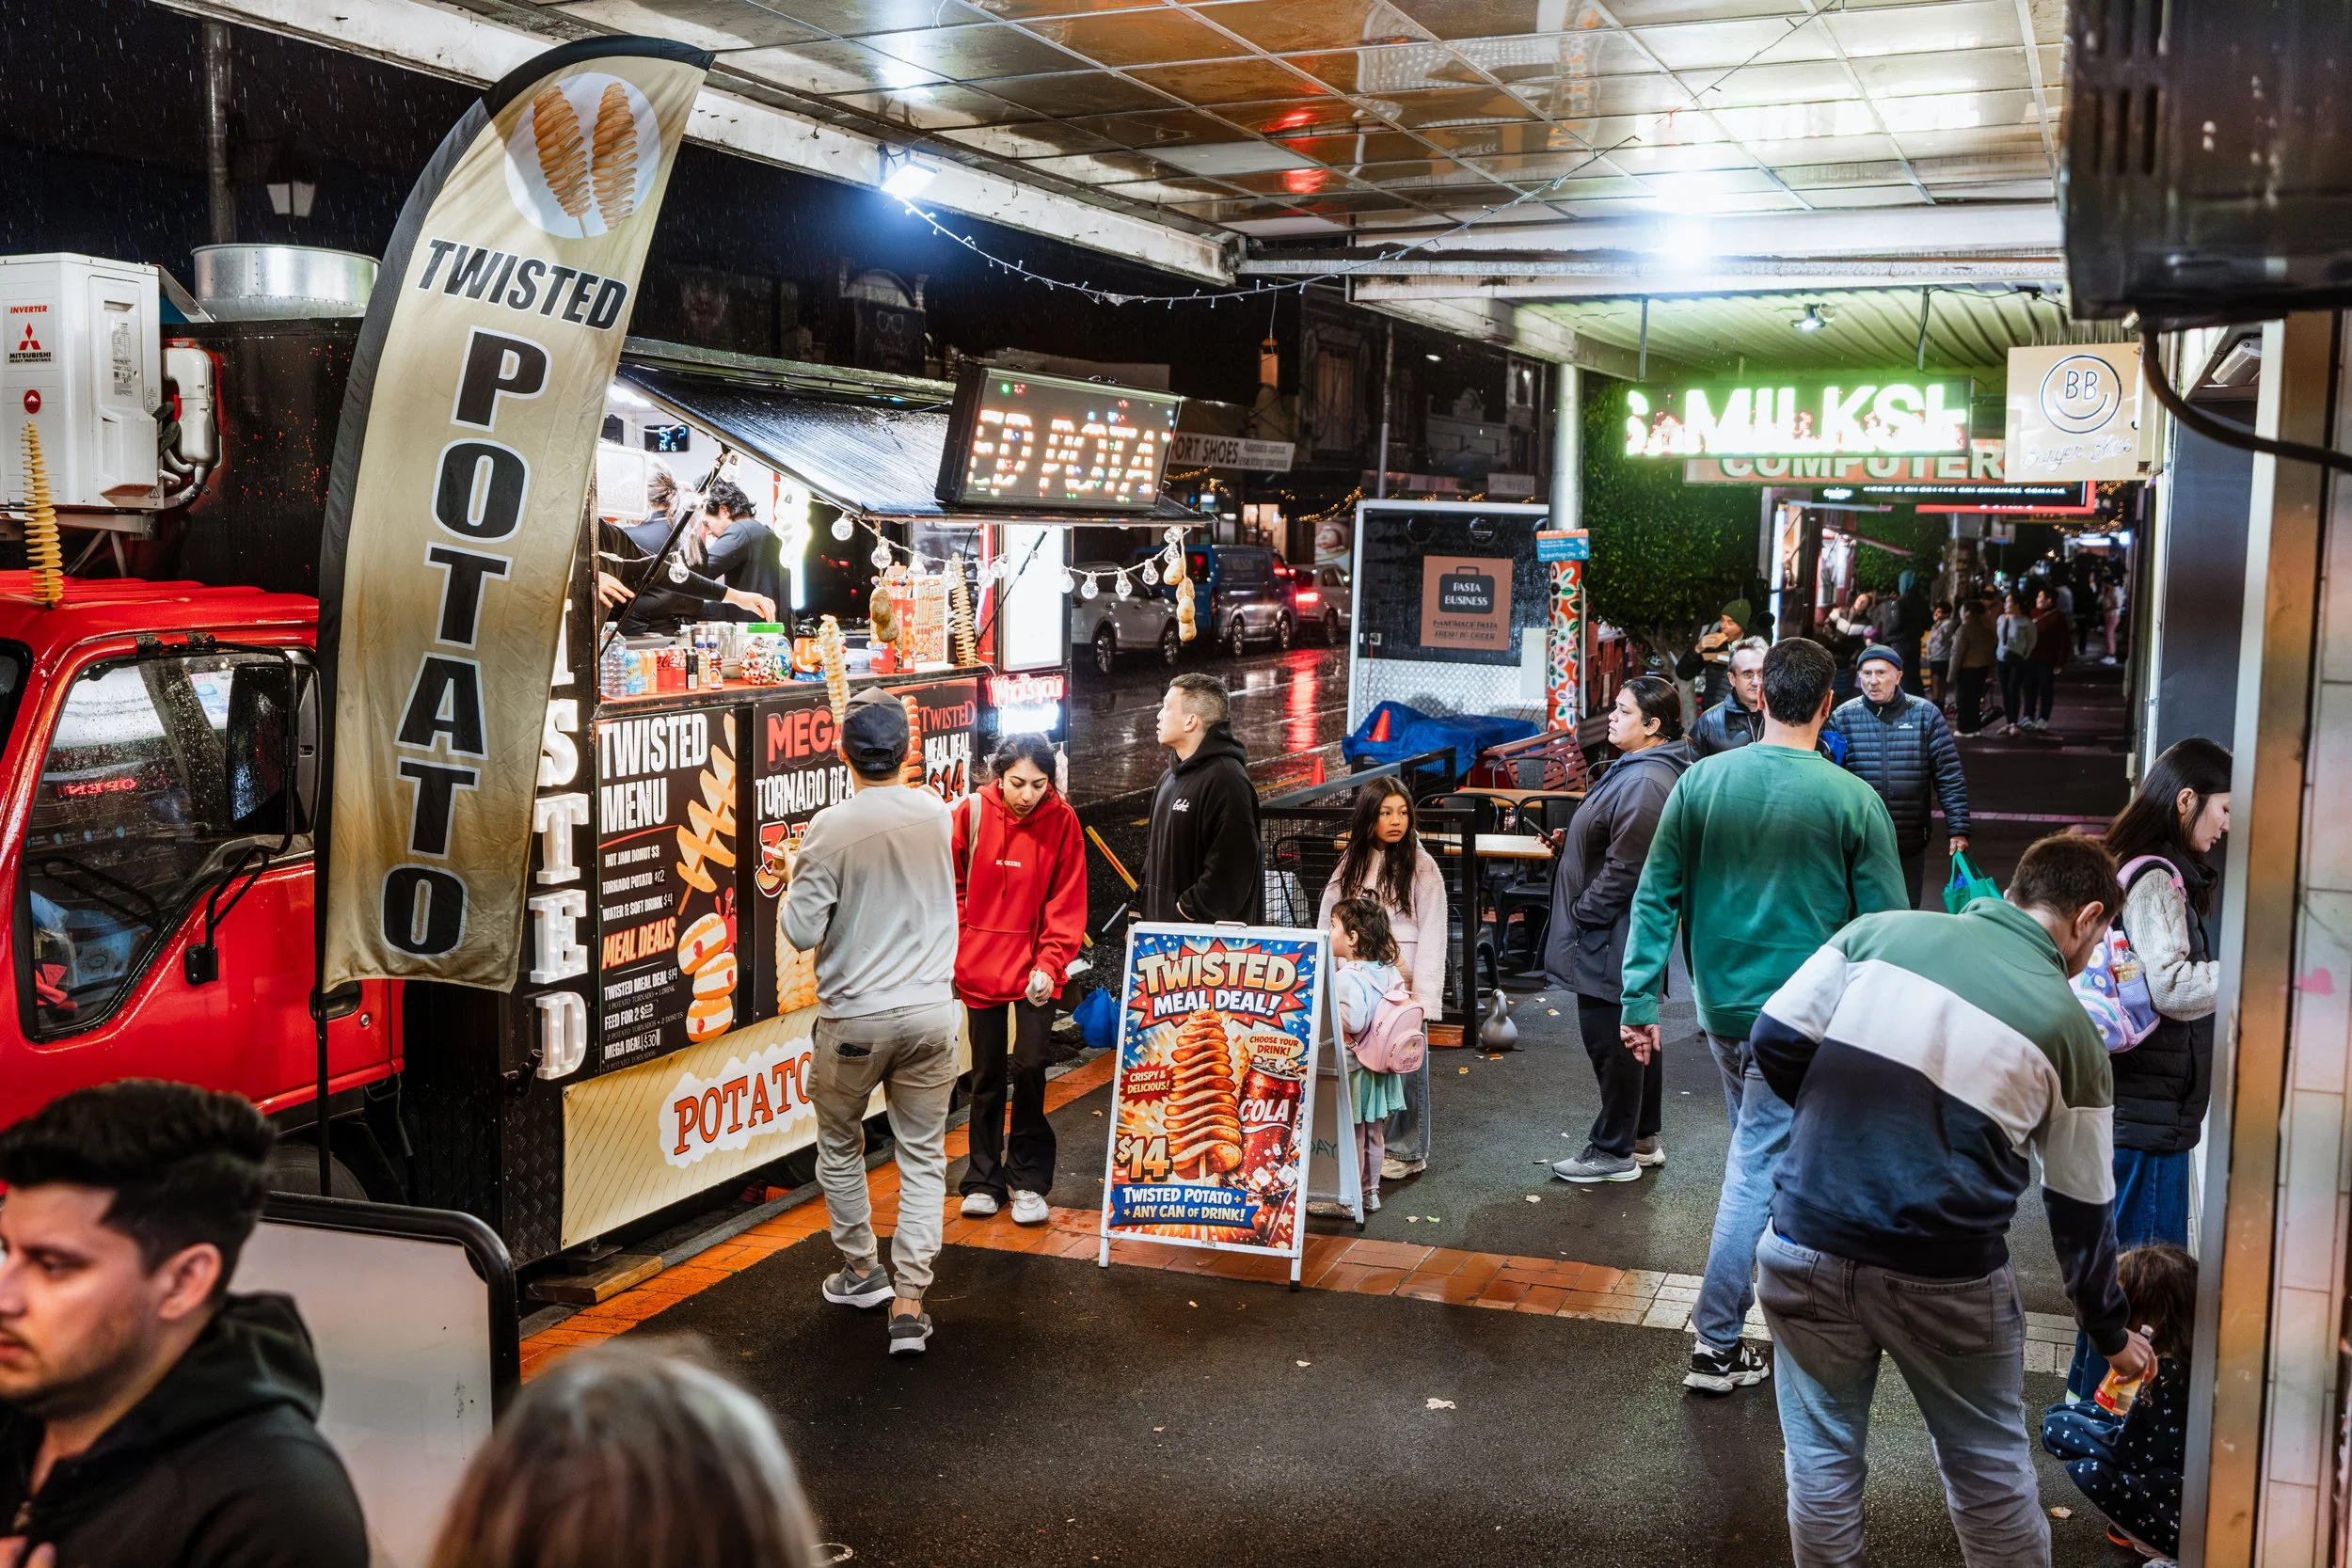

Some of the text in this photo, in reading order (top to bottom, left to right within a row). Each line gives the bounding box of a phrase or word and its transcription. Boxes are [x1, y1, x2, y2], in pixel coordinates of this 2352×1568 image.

[417, 237, 629, 332] TWISTED
[10, 306, 48, 314] INVERTER
[2065, 370, 2098, 400] BB
[1172, 436, 1200, 461] ORT
[1202, 438, 1239, 464] SHOES
[1444, 595, 1487, 606] BUSINESS
[1453, 582, 1481, 593] PASTA
[380, 325, 550, 958] POTATO
[919, 700, 976, 733] TWISTED
[597, 712, 708, 780] TWISTED
[924, 732, 970, 763] MEAL DEAL
[755, 768, 826, 820] TORNADO
[929, 758, 965, 803] $14
[601, 777, 668, 834] MENU
[605, 845, 660, 867] HOT JAM DONUT $3
[602, 869, 665, 895] TORNADO POTATO $12
[602, 893, 674, 922] WATER & SOFT DRINK $4
[601, 916, 676, 971] MEAL DEALS
[604, 967, 677, 1001] TWISTED MEAL DEAL $14
[1136, 951, 1298, 996] TWISTED
[612, 997, 632, 1009] POTATO
[632, 991, 655, 1004] TORNADO
[1152, 989, 1282, 1017] MEAL DEAL!
[604, 1013, 620, 1031] FEED
[621, 1006, 634, 1026] FOR
[634, 1006, 640, 1022] 2
[612, 1028, 632, 1040] POTATO
[632, 1020, 657, 1035] TORNADOS
[665, 1011, 684, 1023] DONUTS
[604, 1033, 657, 1060] MEGA DEAL $30
[1249, 1035, 1299, 1048] CHOOSE YOUR
[1257, 1044, 1291, 1056] DRINK!
[611, 1057, 630, 1069] POTATO
[1130, 1069, 1167, 1082] CRISPY &
[1127, 1080, 1170, 1095] DELICIOUS!
[674, 1051, 814, 1155] POTATO
[1239, 1099, 1290, 1123] COLA
[1116, 1135, 1170, 1180] $14
[1122, 1186, 1182, 1204] TWISTED
[1184, 1189, 1232, 1205] POTATO
[1132, 1205, 1157, 1219] ANY
[1159, 1204, 1185, 1219] CAN
[1200, 1207, 1246, 1222] DRINK!
